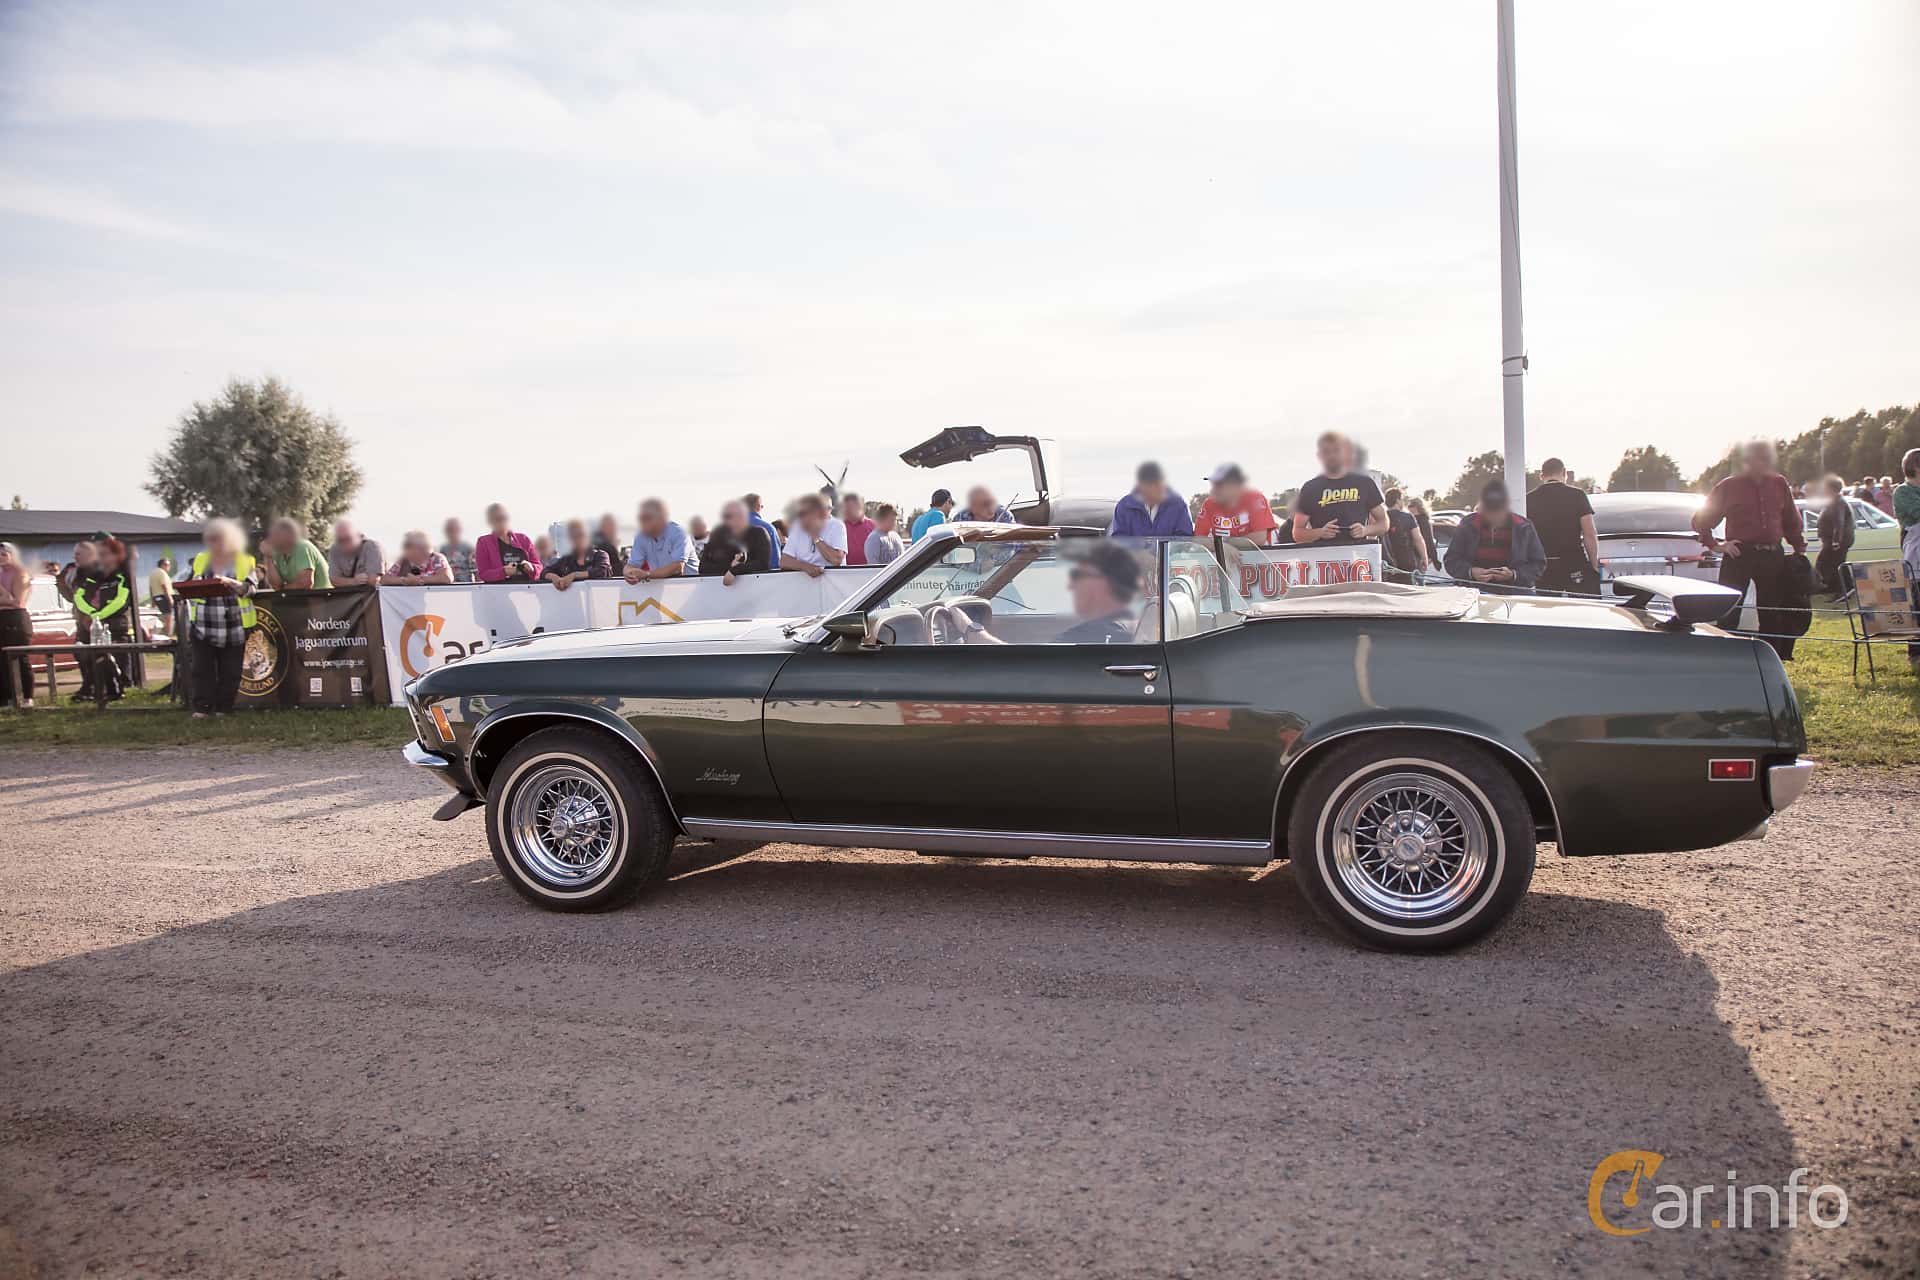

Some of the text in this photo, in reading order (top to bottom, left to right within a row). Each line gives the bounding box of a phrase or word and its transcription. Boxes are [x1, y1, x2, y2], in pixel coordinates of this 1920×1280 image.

[1239, 558, 1373, 598] PULLING
[307, 617, 351, 631] Nordens
[294, 636, 368, 652] Jaguarcentrum
